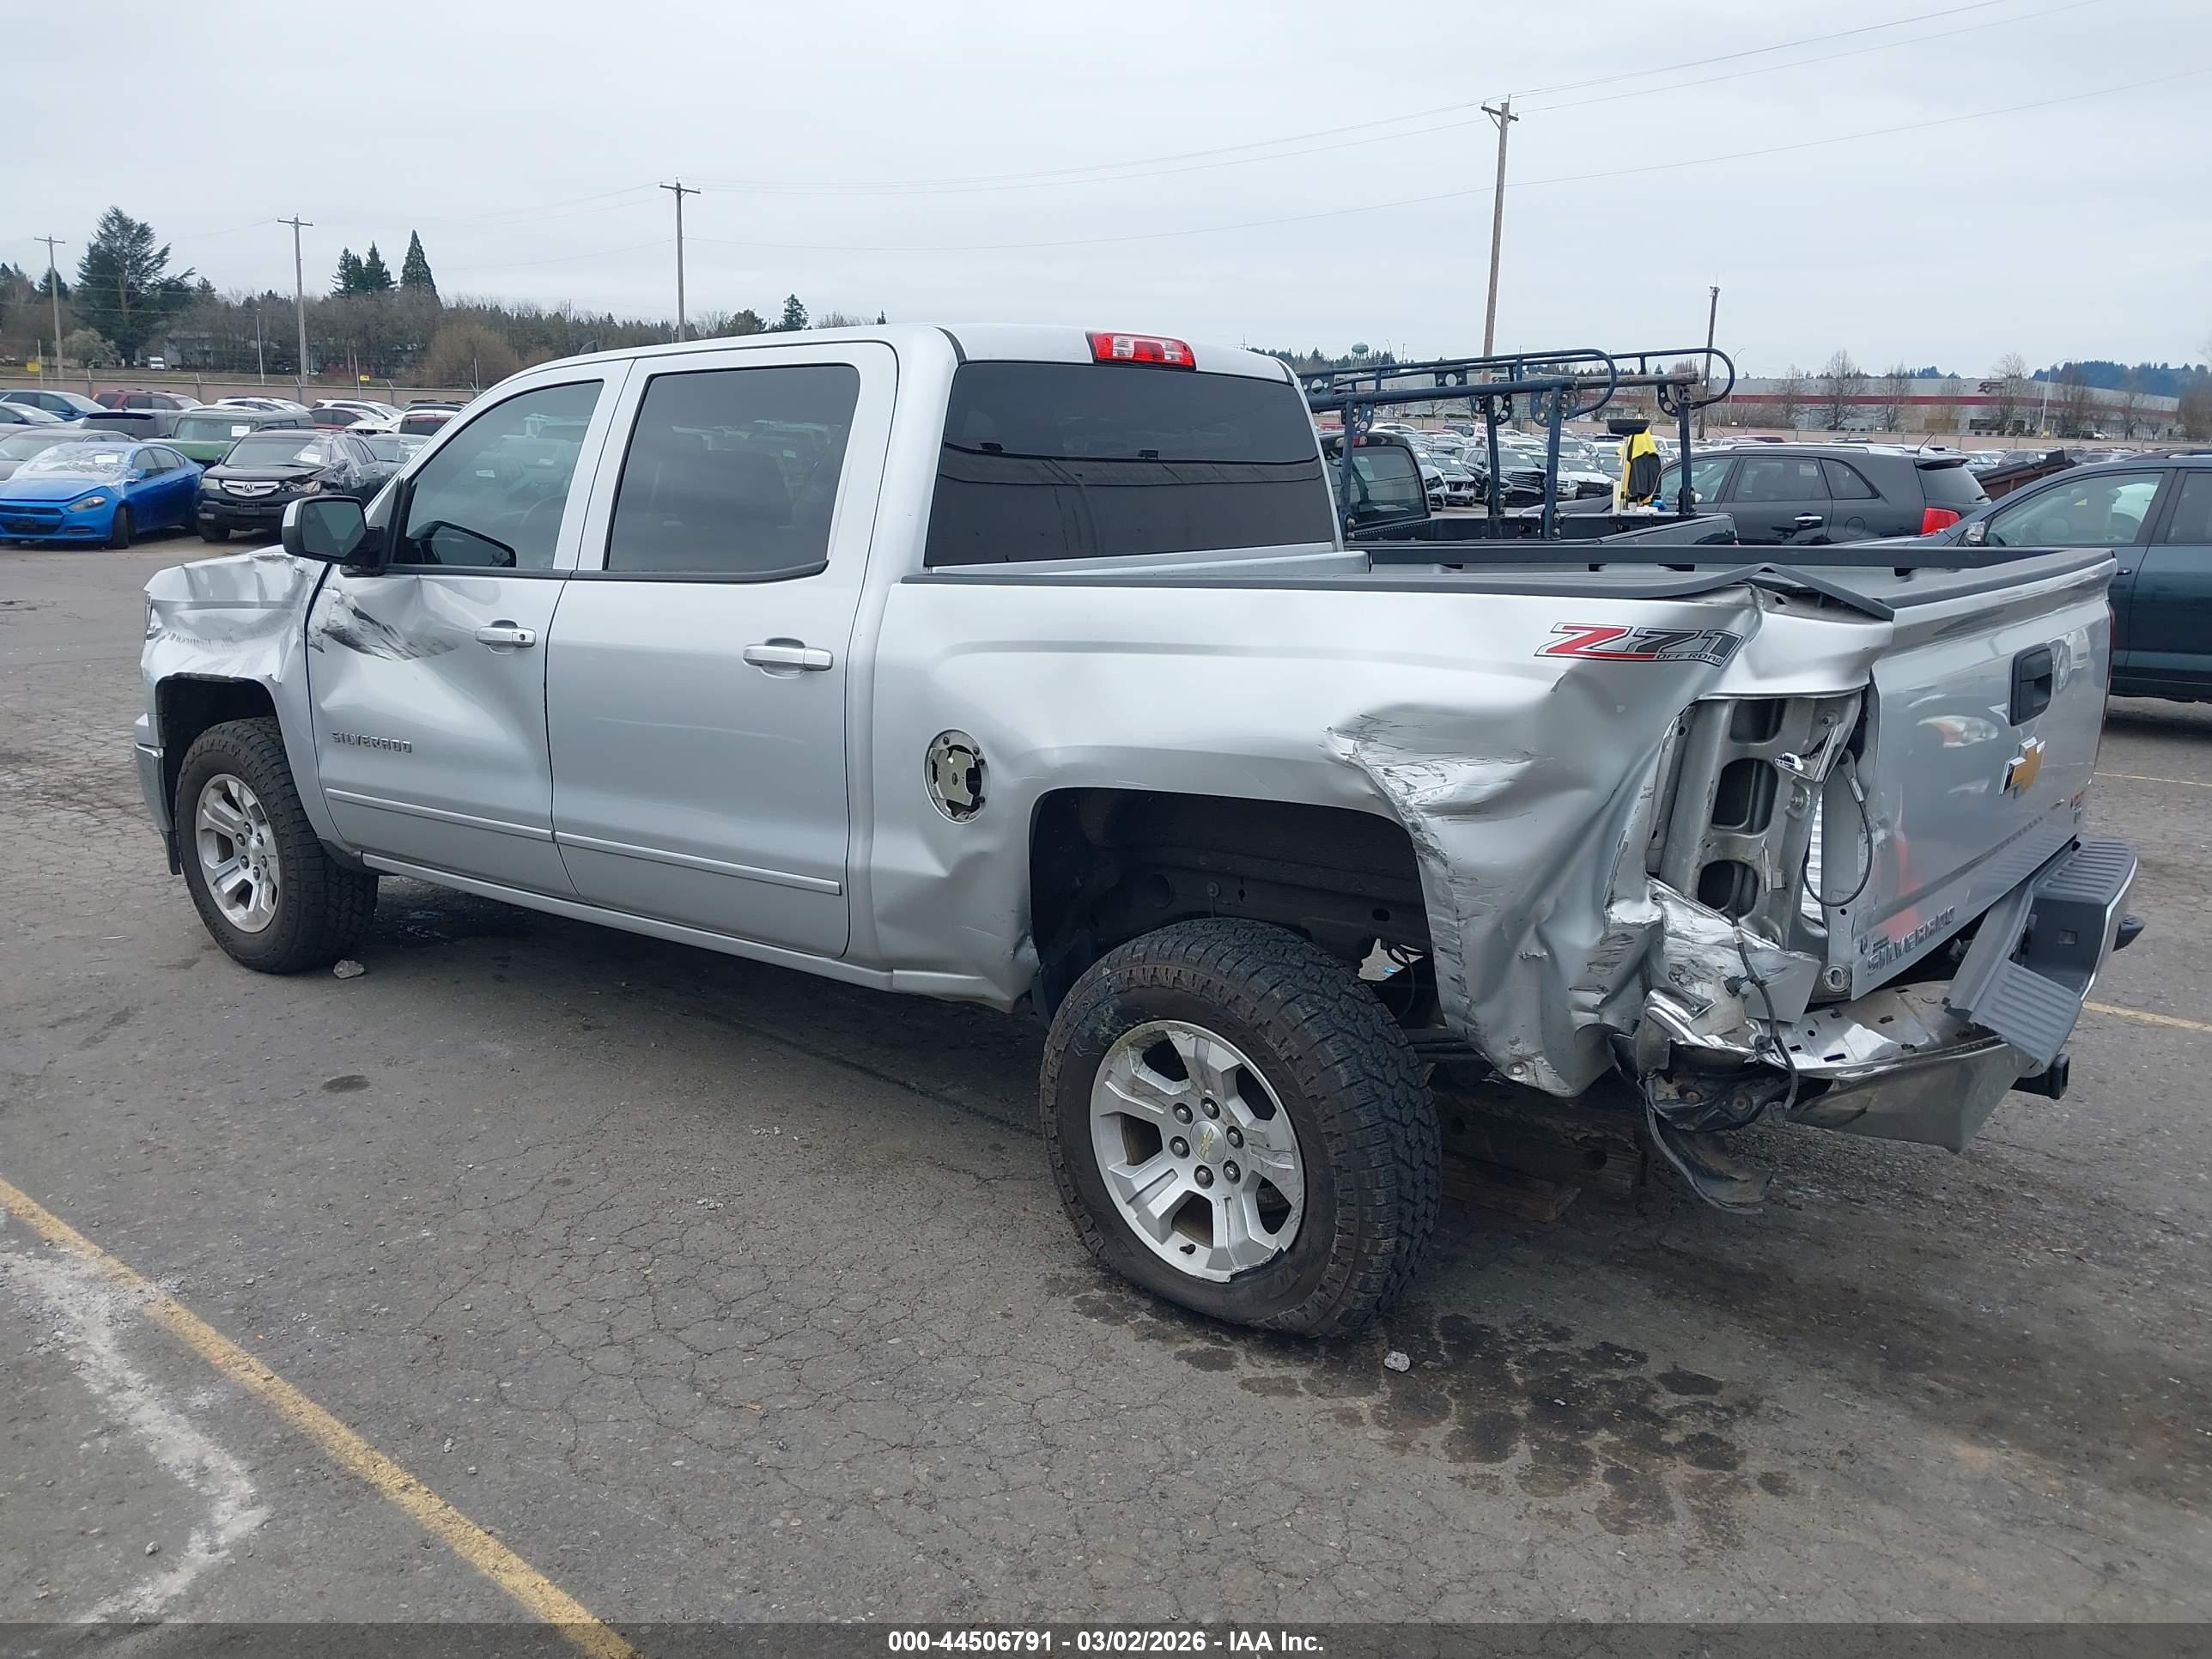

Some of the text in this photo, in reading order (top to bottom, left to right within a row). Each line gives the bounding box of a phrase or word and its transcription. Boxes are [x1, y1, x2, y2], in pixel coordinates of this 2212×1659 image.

[1534, 622, 1744, 667] Z71
[1687, 653, 1723, 665] ROAD
[331, 731, 412, 753] SILVERADO
[1867, 905, 1955, 976] SILVERADO
